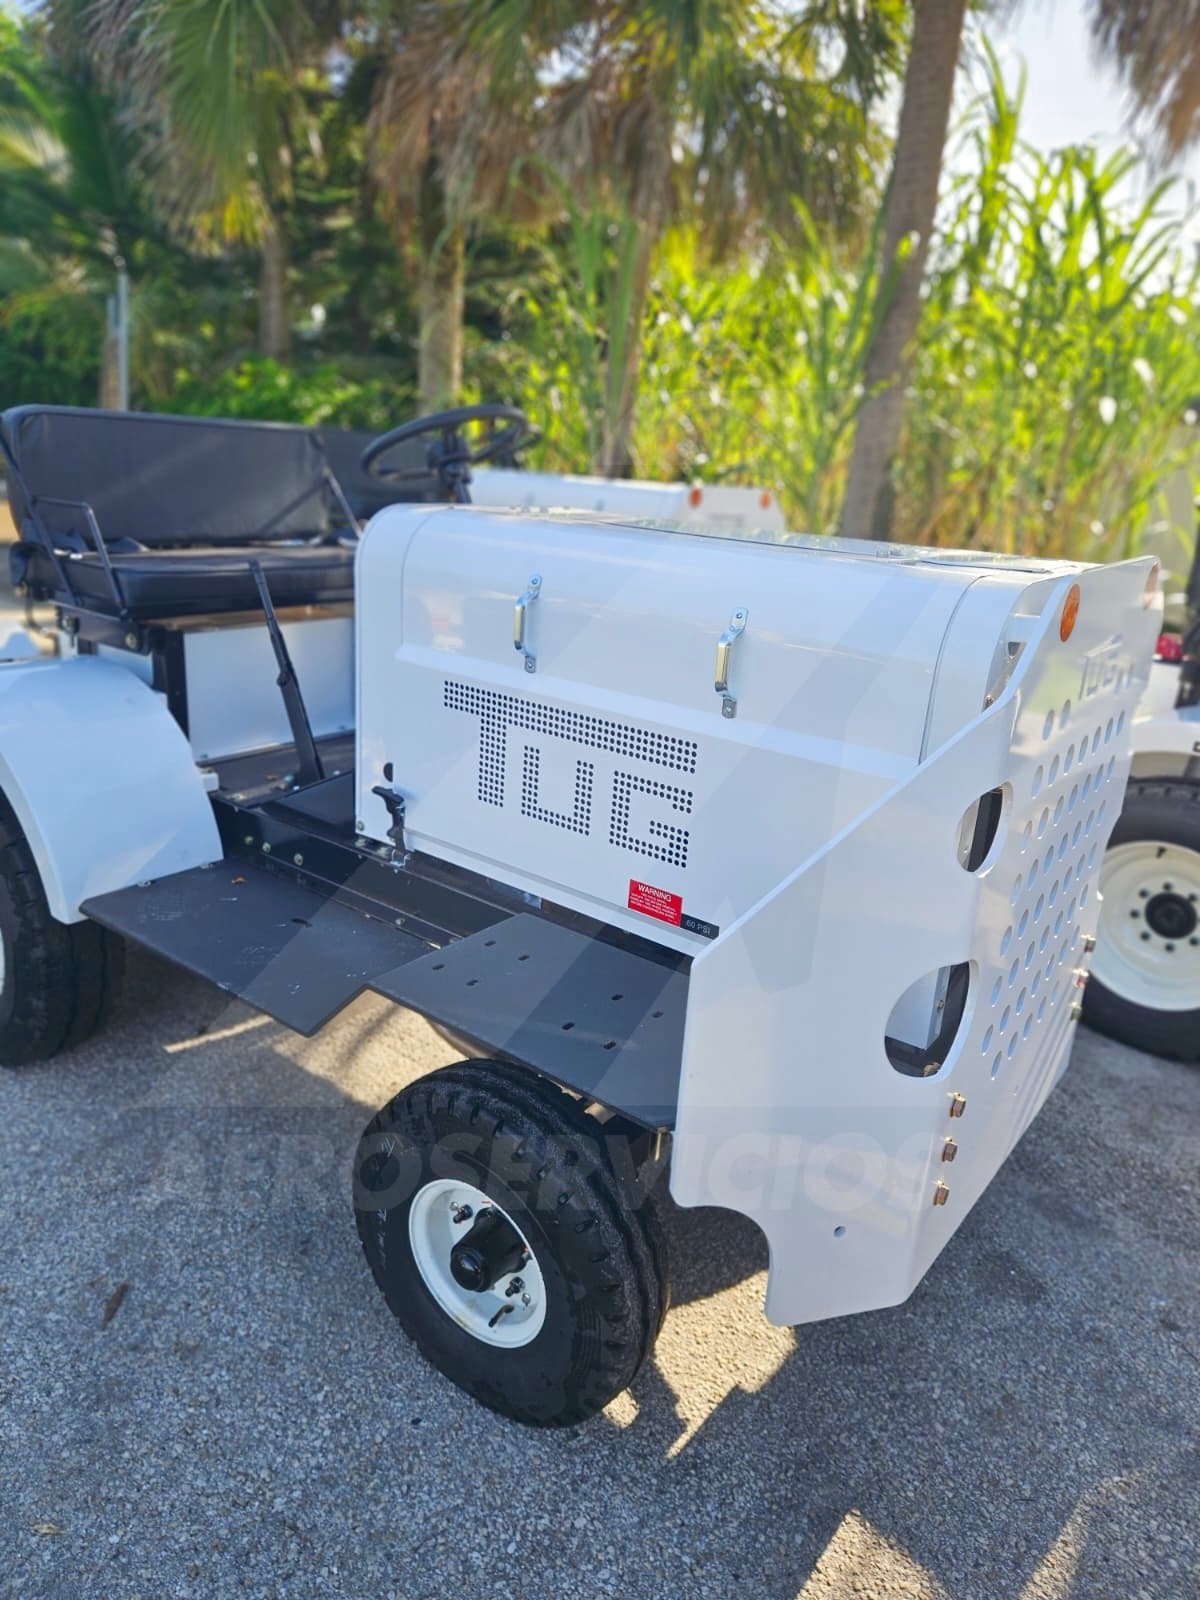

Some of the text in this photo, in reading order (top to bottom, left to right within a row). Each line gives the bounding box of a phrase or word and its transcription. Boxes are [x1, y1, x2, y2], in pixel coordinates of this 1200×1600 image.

[443, 680, 698, 868] TUG
[638, 884, 672, 902] WARNING
[686, 920, 711, 936] 60 PSI
